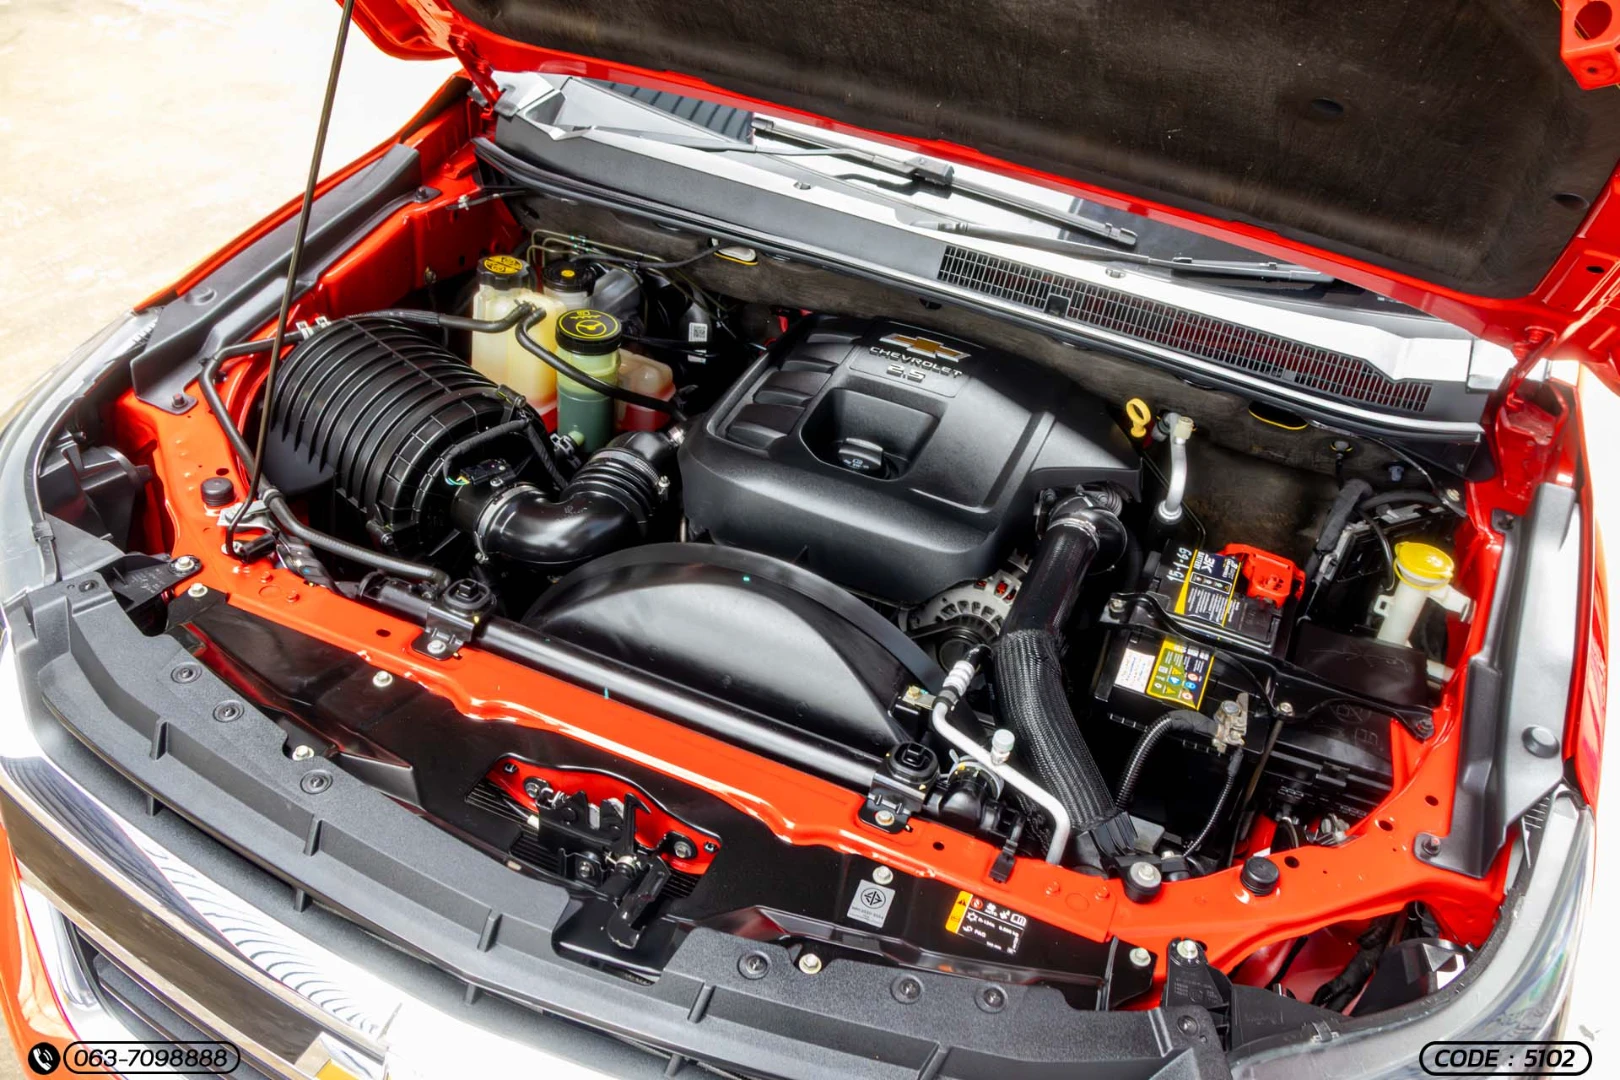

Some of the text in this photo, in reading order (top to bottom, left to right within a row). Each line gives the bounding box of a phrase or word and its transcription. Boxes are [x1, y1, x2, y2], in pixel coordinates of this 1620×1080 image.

[869, 346, 962, 378] CHEVROLET
[887, 363, 926, 382] 2.5
[1201, 553, 1215, 574] 3K
